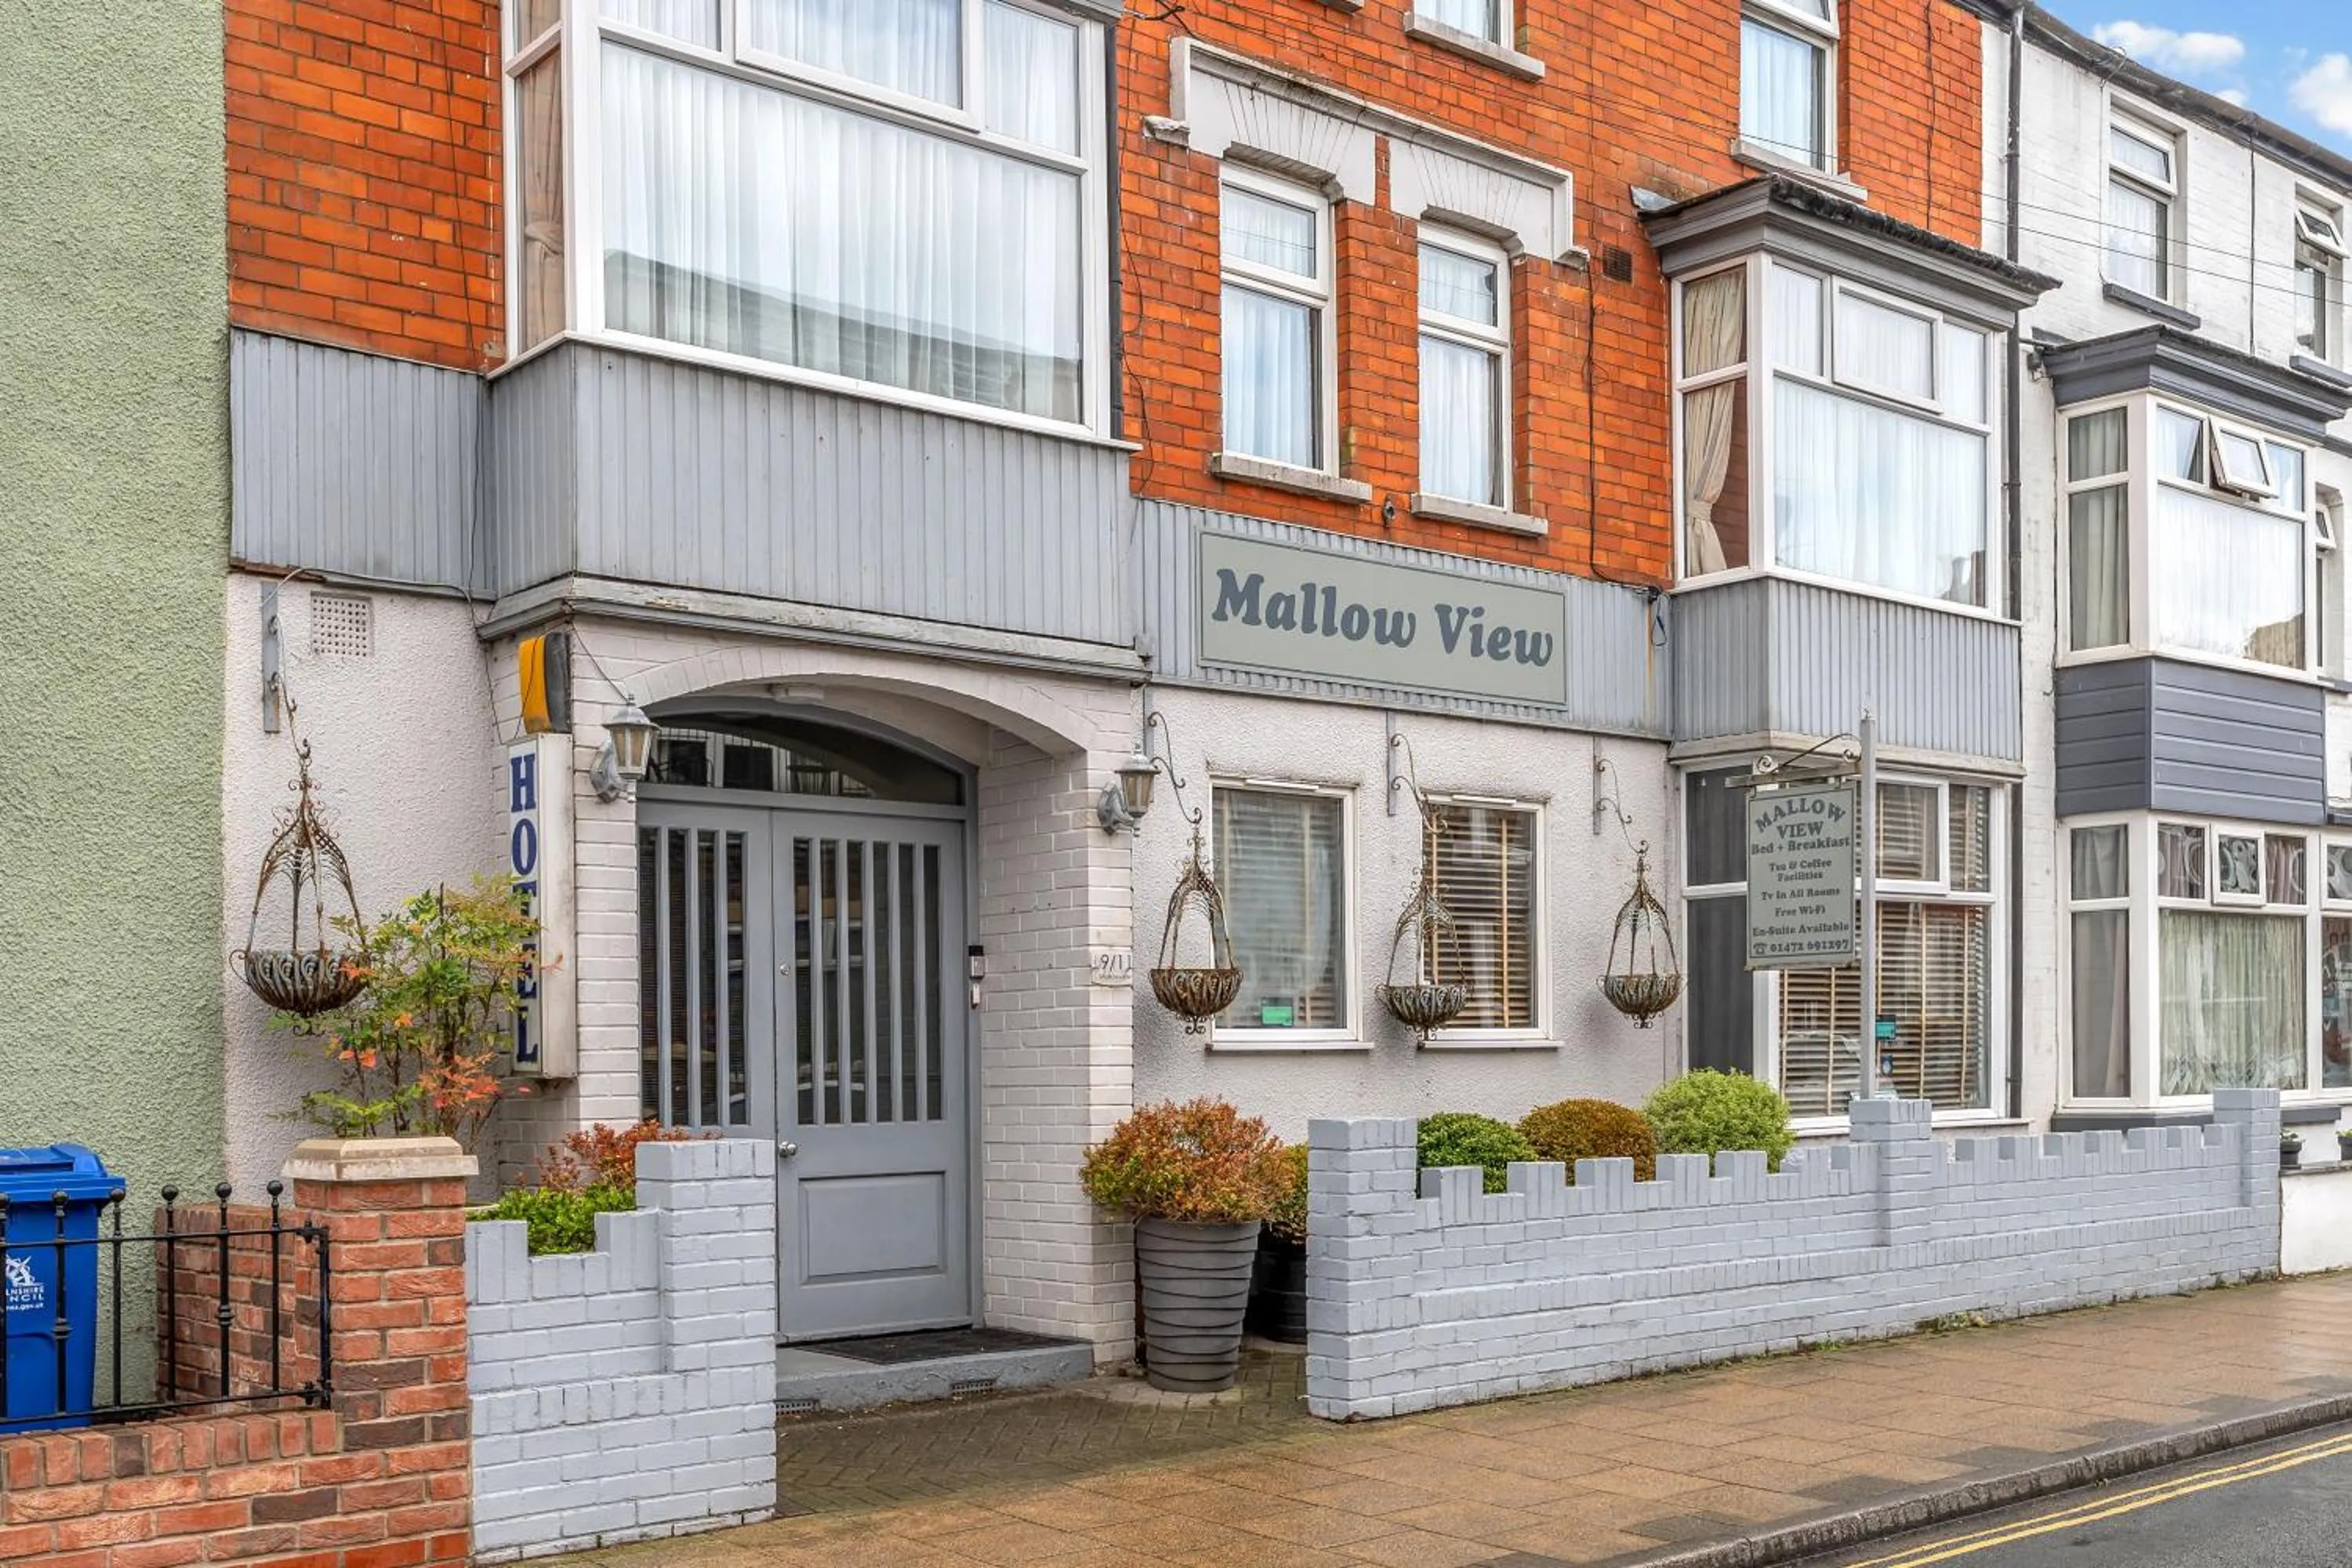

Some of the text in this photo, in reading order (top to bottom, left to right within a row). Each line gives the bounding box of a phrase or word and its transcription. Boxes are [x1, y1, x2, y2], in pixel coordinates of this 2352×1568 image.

[1211, 568, 1554, 667] Mallow View
[1755, 797, 1846, 833] MALLOW
[1777, 821, 1824, 839] VIEW
[1751, 842, 1774, 855] Bed
[1788, 837, 1850, 853] Breakfast
[1769, 863, 1787, 873] Tea
[1799, 858, 1832, 870] Coffee
[1777, 870, 1824, 883] Facilities
[1789, 888, 1805, 899] All
[1806, 887, 1841, 898] Rooms
[1774, 906, 1797, 918] Free
[1798, 921, 1849, 935] Available
[1770, 942, 1804, 954] 01472
